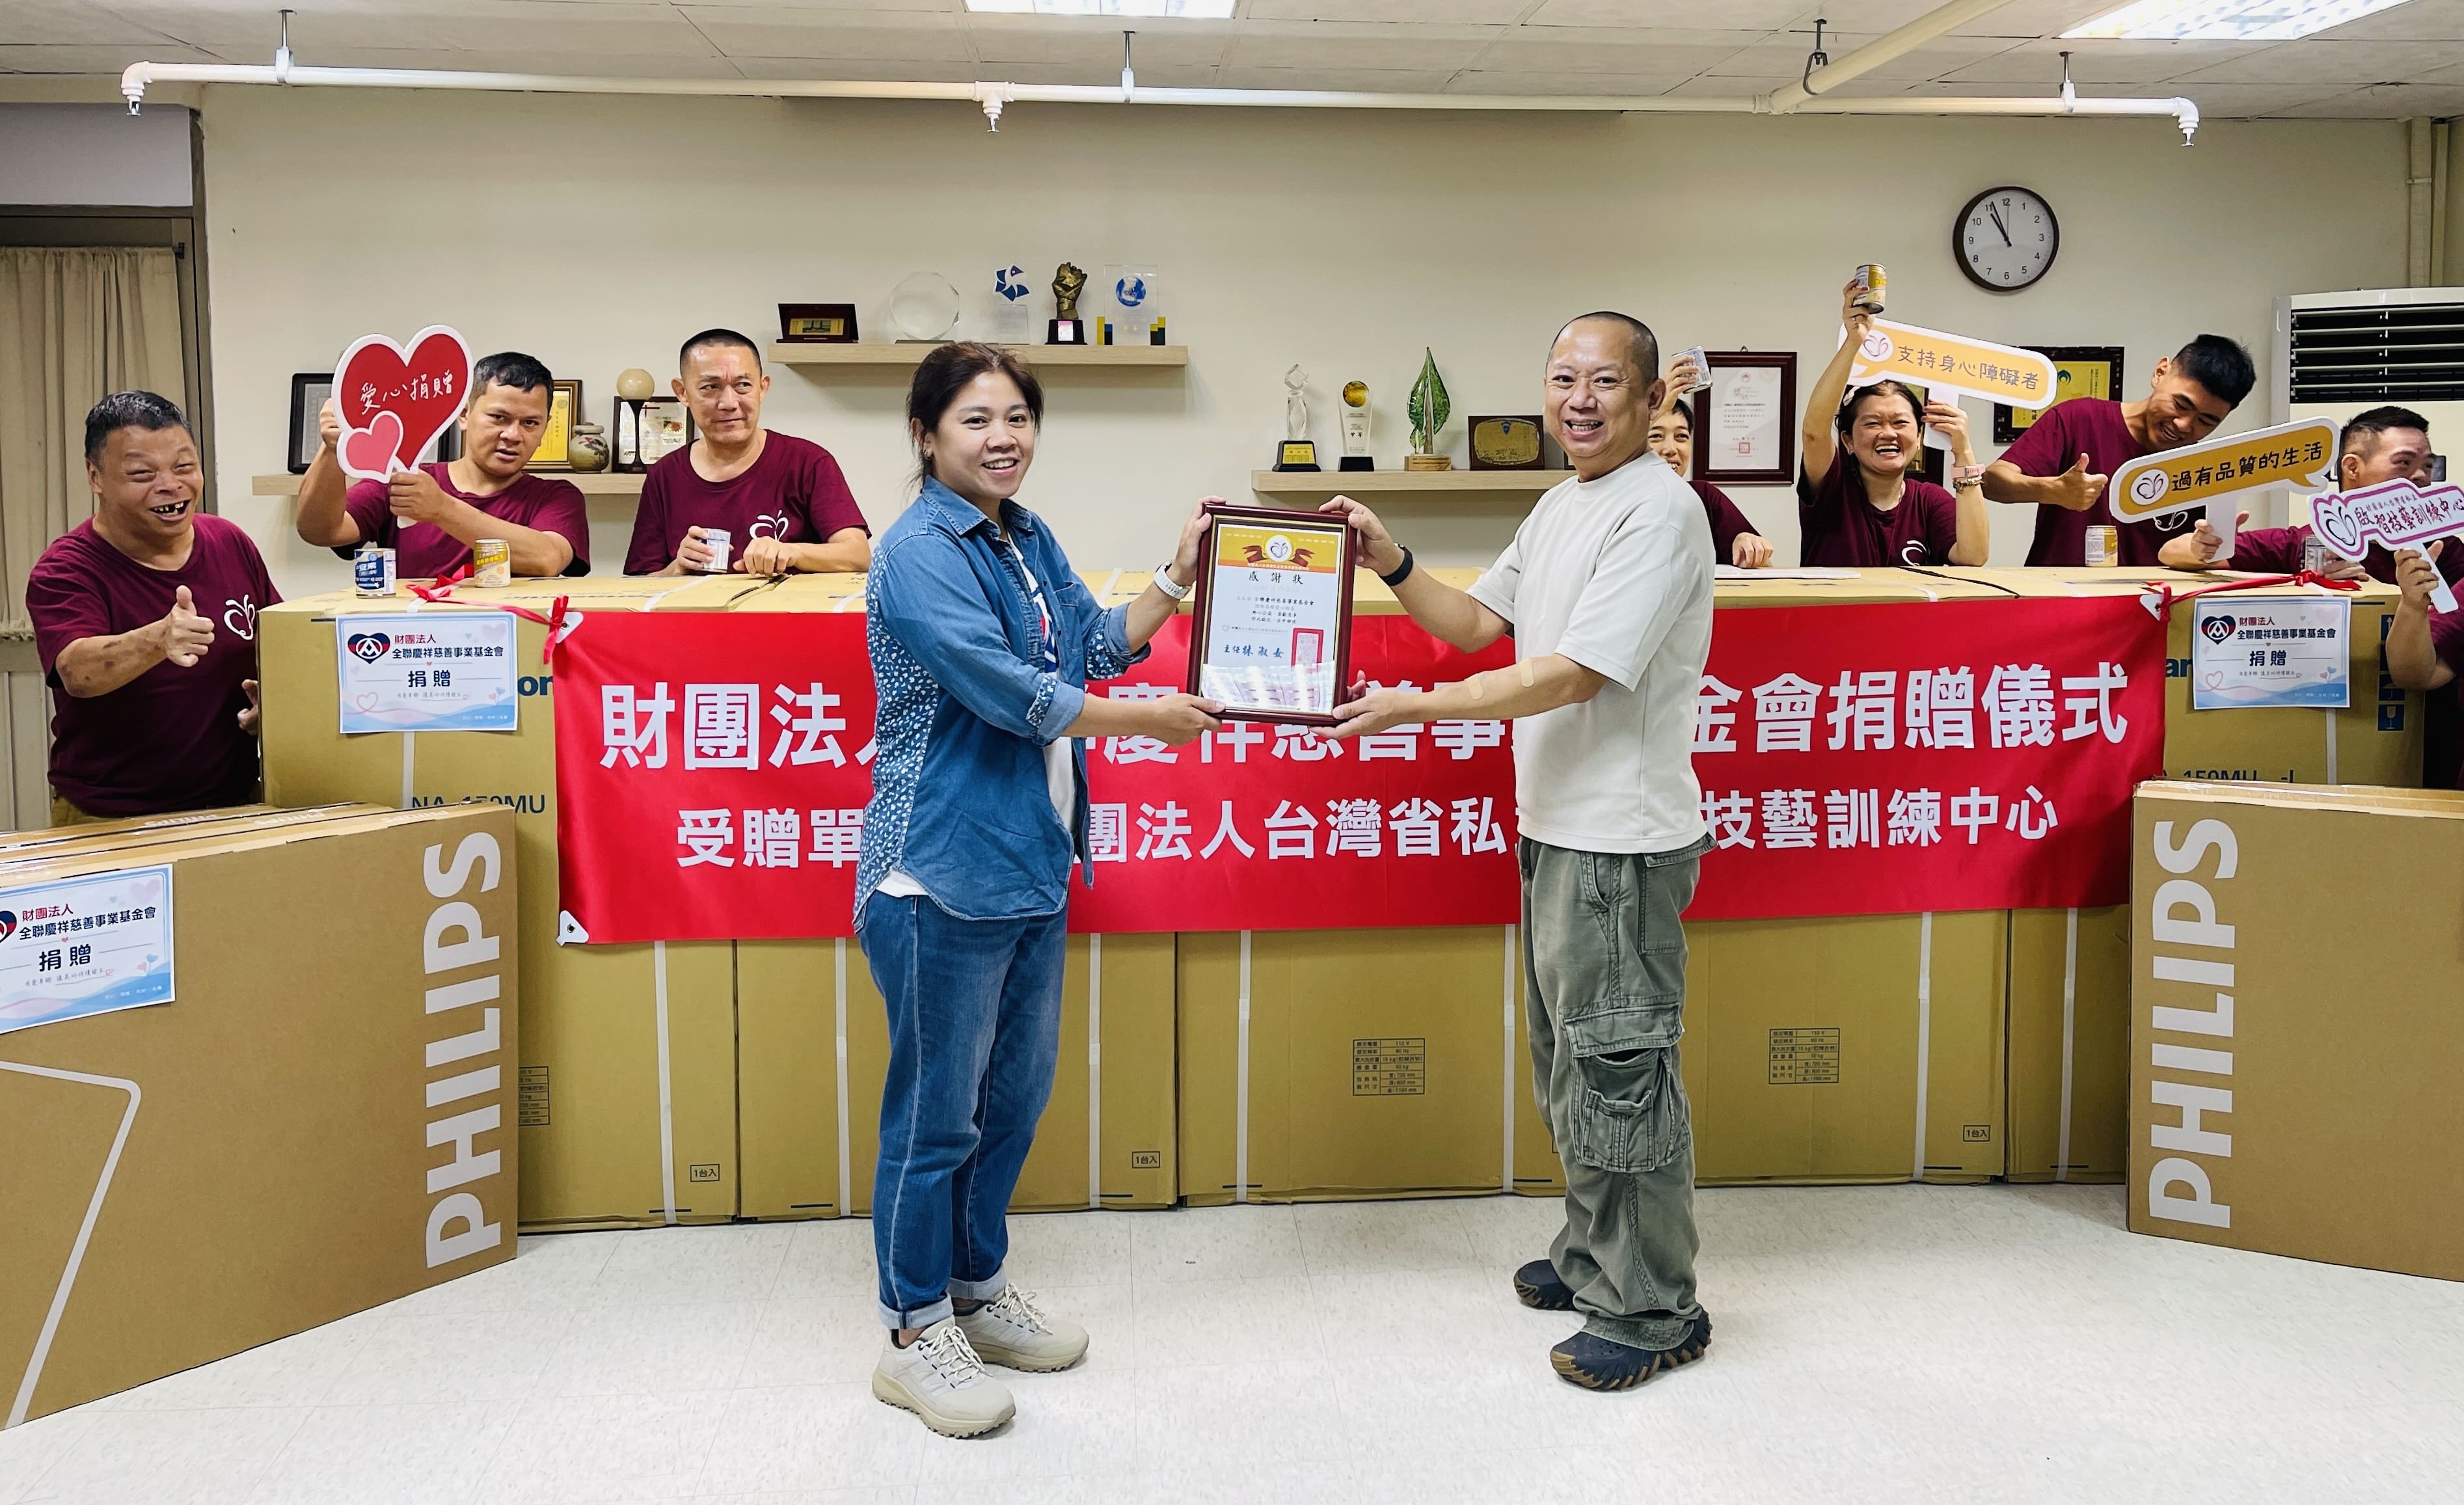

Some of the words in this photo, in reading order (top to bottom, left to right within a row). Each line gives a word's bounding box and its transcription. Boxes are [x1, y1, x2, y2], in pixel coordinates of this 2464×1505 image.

[1986, 267, 1992, 276] 7
[1898, 346, 2038, 390] 支持身心障礙者
[360, 370, 453, 415] 愛心捐贈
[2171, 441, 2323, 491] 過有品質的生活
[1249, 571, 1303, 584] 感謝狀
[2239, 617, 2275, 626] 財團法人
[394, 634, 437, 644] 財團法人
[2237, 628, 2336, 640] 全聯慶祥慈善事業基金會
[392, 646, 504, 659] 全聯慶祥慈善事業基金會
[2249, 650, 2286, 666] 捐贈
[408, 670, 450, 688] 捐贈
[22, 904, 74, 922] 財團法人
[20, 906, 156, 940] 全聯慶祥慈善事業基金會
[39, 943, 91, 972] 捐贈
[2149, 818, 2238, 1228] PHILIPS
[423, 832, 501, 1268] PHILIPS
[1136, 1156, 1157, 1164] 1台入
